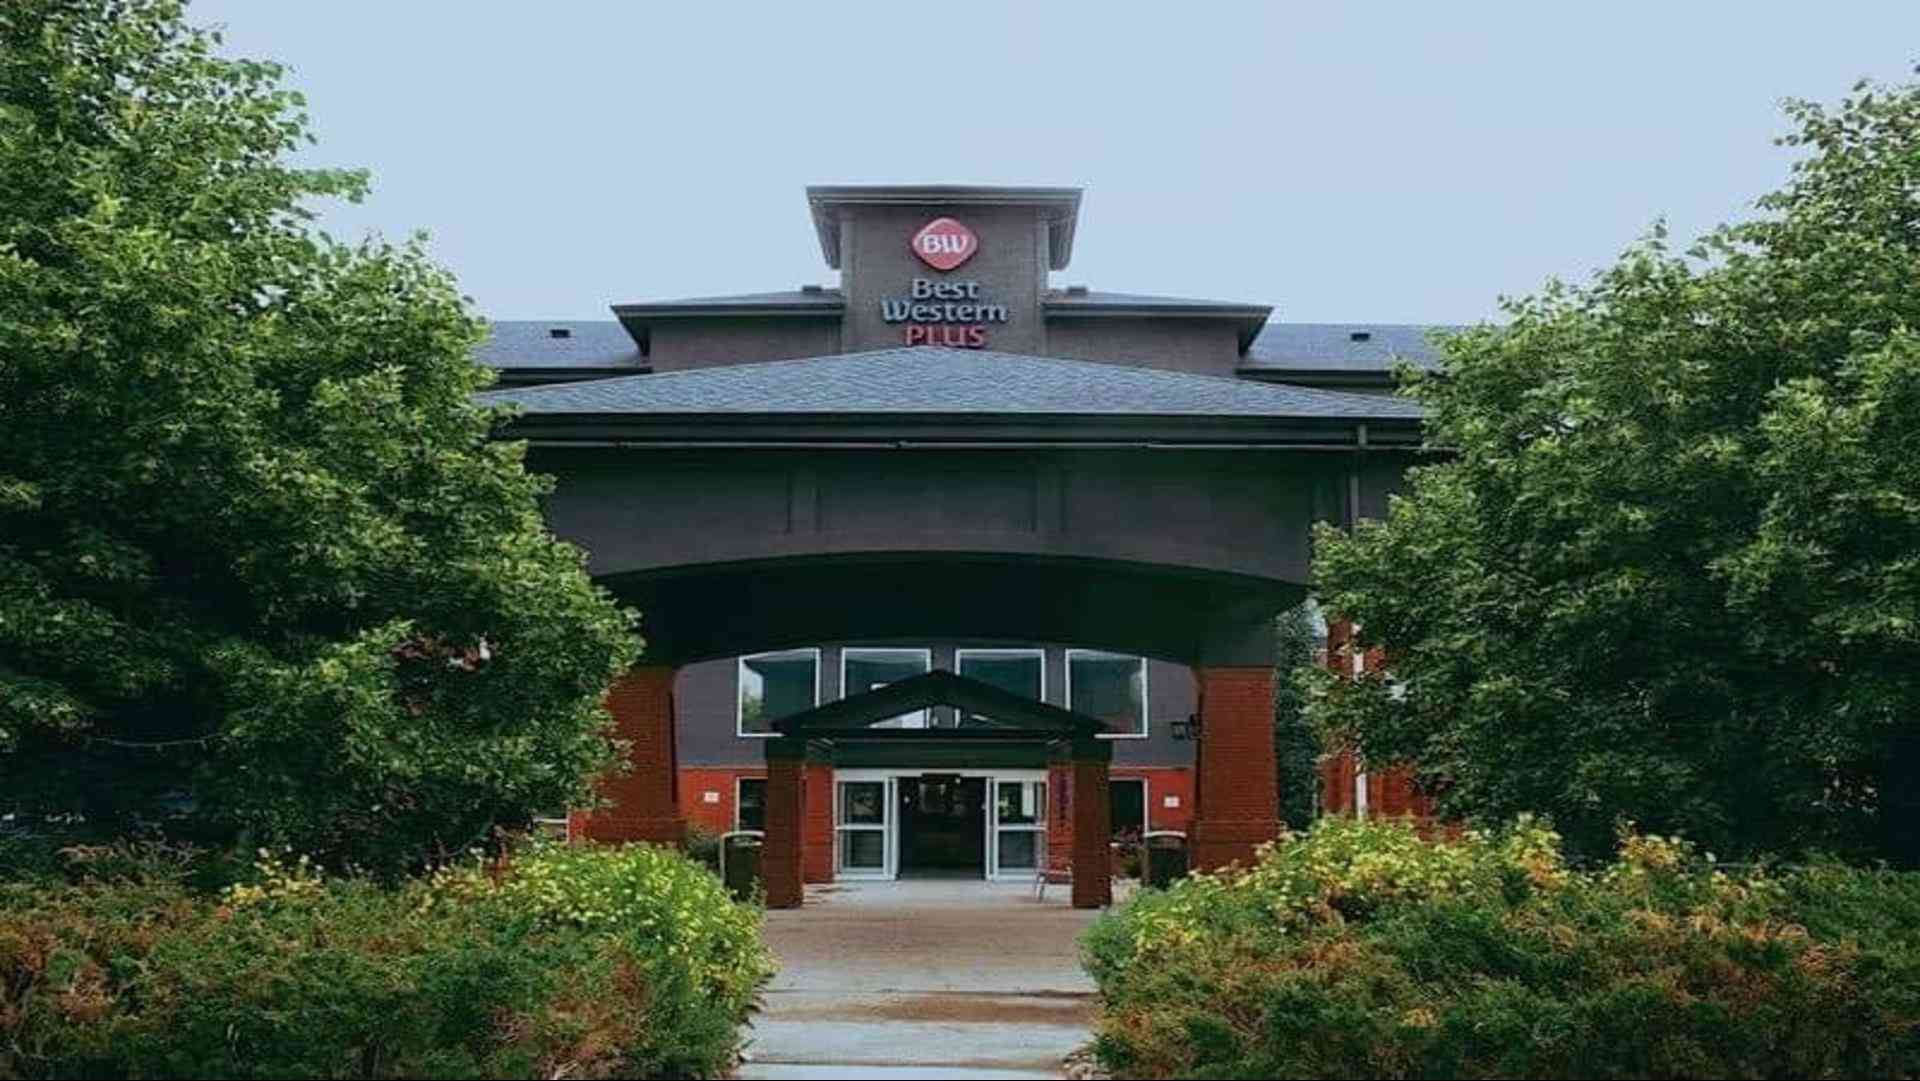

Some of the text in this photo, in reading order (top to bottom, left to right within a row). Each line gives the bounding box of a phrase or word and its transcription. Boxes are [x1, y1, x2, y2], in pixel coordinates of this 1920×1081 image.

[922, 233, 968, 253] BW
[912, 278, 980, 299] Best
[880, 299, 1008, 322] Western
[906, 325, 986, 346] PLUS
